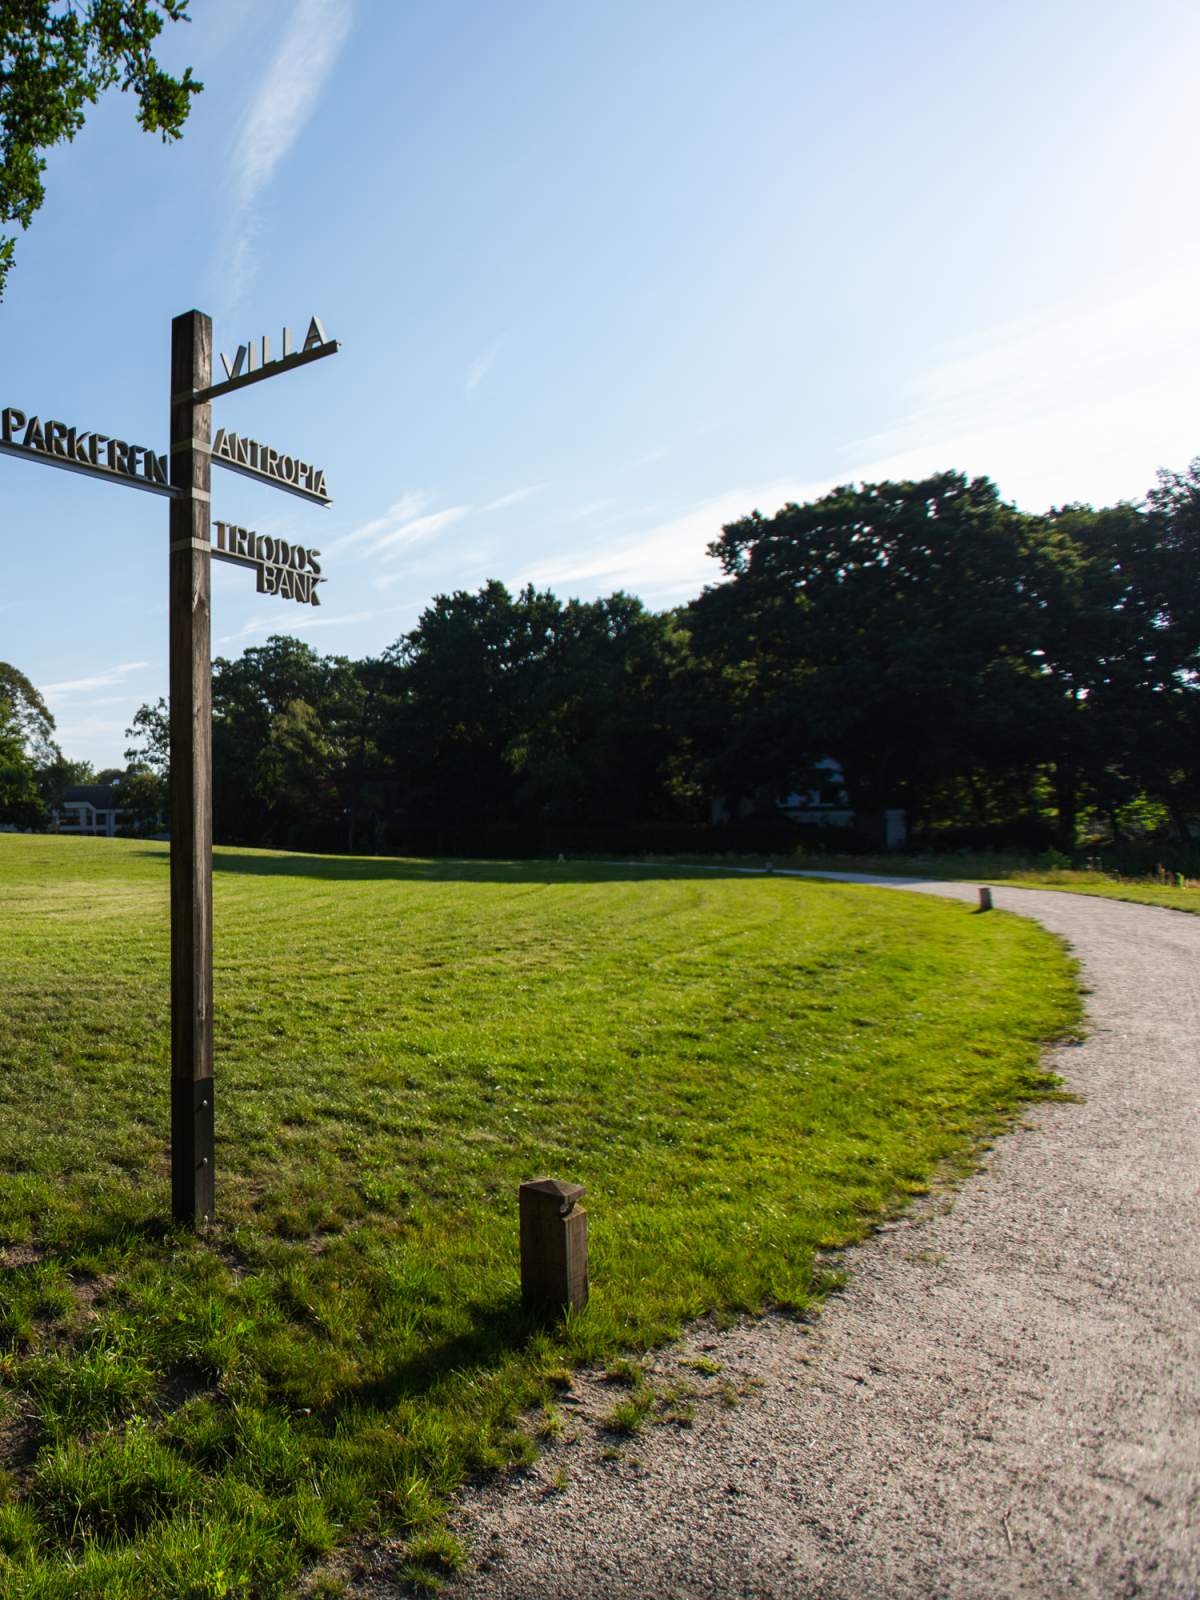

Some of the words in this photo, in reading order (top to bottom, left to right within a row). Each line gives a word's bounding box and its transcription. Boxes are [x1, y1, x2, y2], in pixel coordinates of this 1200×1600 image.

[220, 315, 328, 380] VILLA
[1, 407, 169, 485] PARKEREN
[213, 428, 328, 497] ANTROPIA
[212, 520, 322, 577] TRIODOS
[257, 565, 326, 606] BANK
